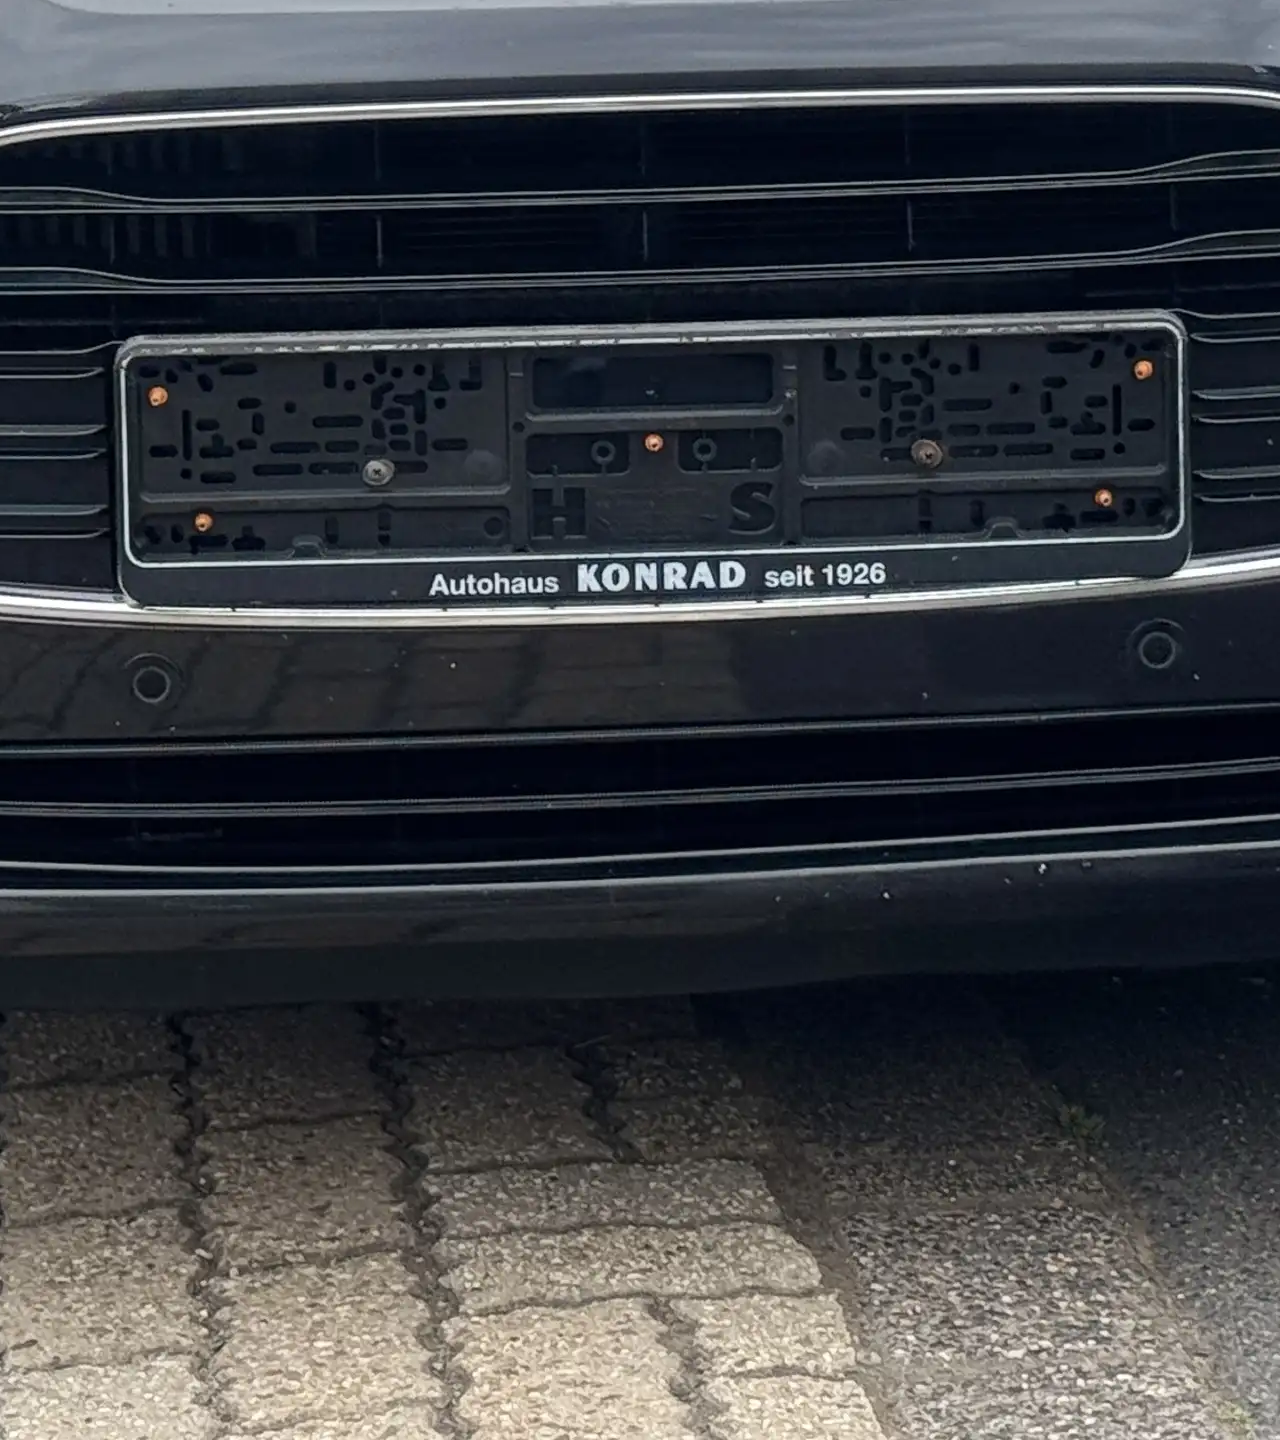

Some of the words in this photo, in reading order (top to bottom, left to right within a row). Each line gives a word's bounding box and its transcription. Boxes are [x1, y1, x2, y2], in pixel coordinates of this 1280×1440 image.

[429, 572, 560, 596] Autohaus
[577, 560, 747, 593] KONRAD
[764, 564, 815, 589] seit
[822, 562, 887, 586] 1926
